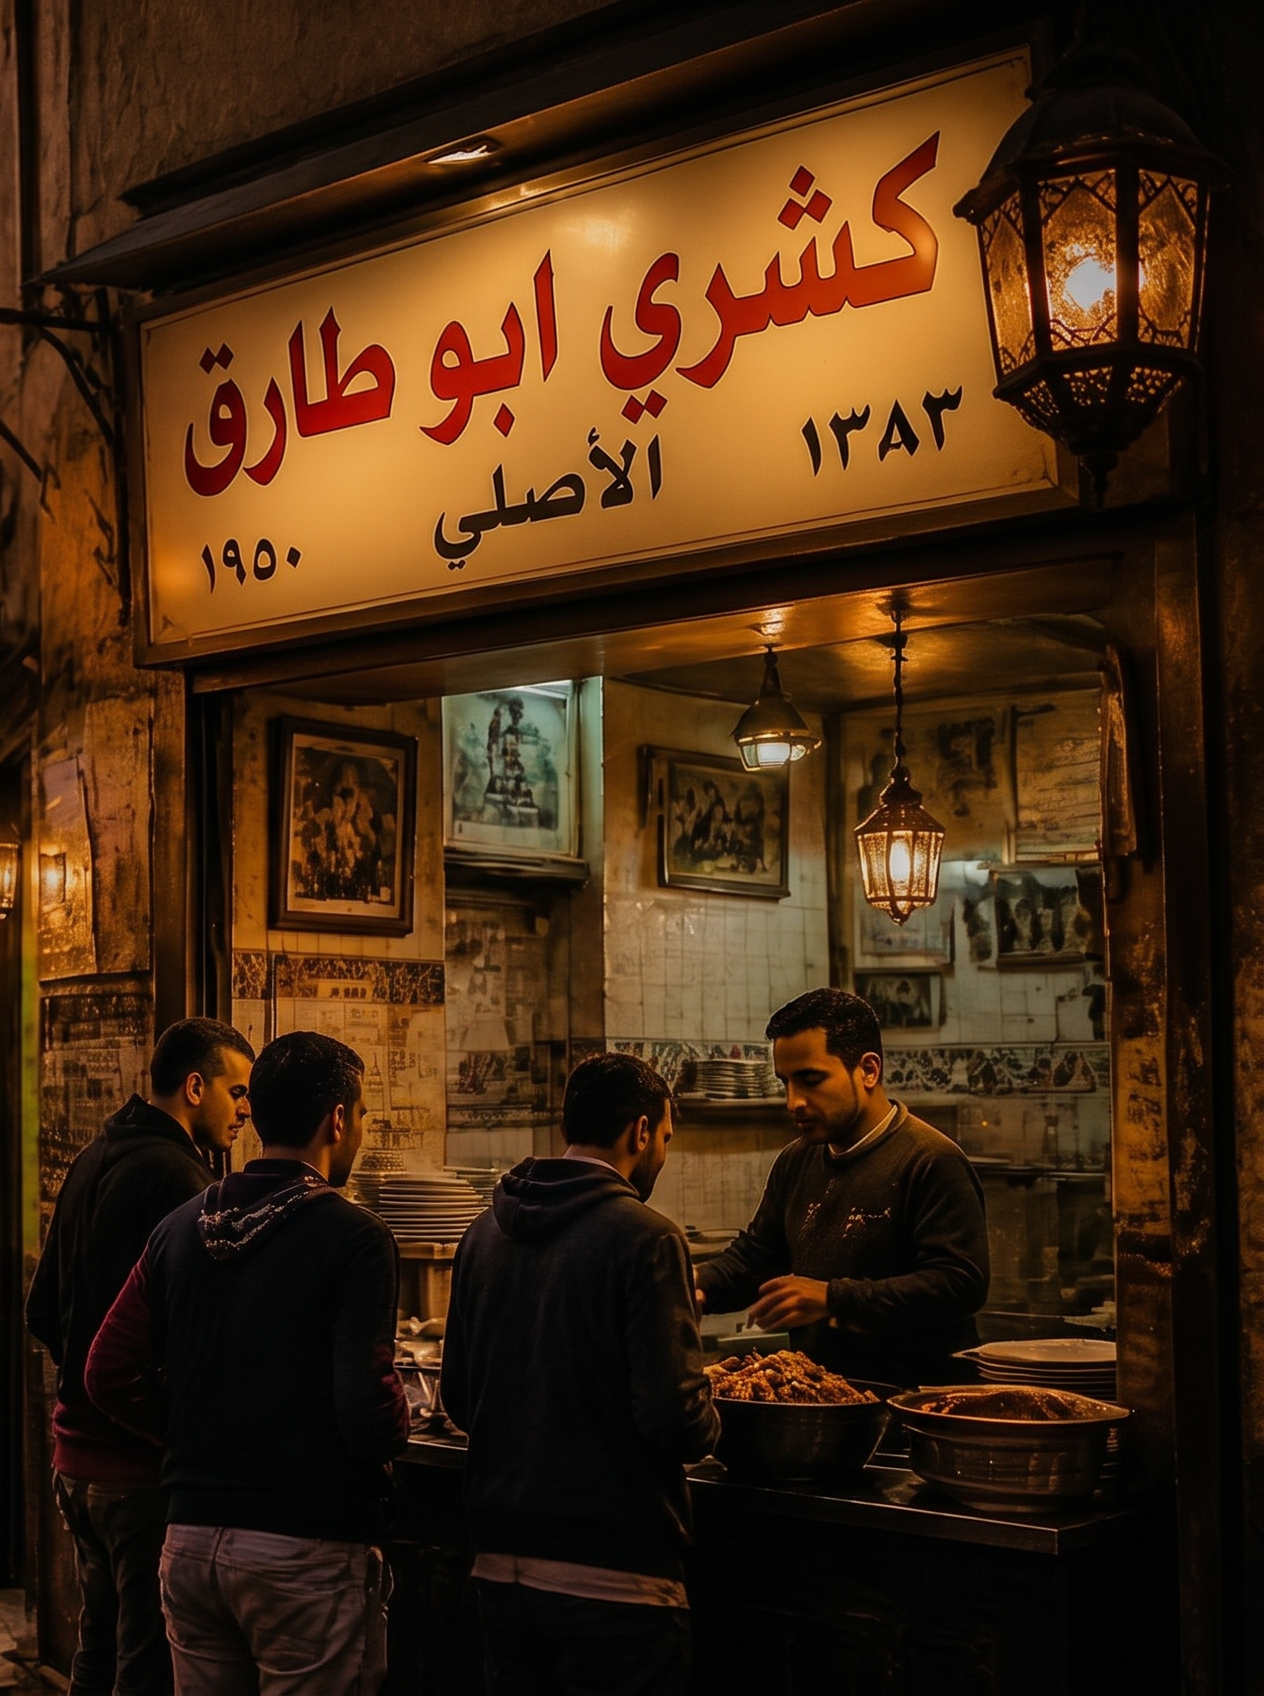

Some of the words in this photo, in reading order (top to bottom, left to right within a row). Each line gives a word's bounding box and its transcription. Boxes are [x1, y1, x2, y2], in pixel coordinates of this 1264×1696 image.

[419, 249, 559, 445] ابو
[599, 130, 940, 424] كشري
[182, 307, 396, 497] طارق
[200, 537, 303, 595] ١٩٥٠
[433, 426, 663, 571] الأصلي
